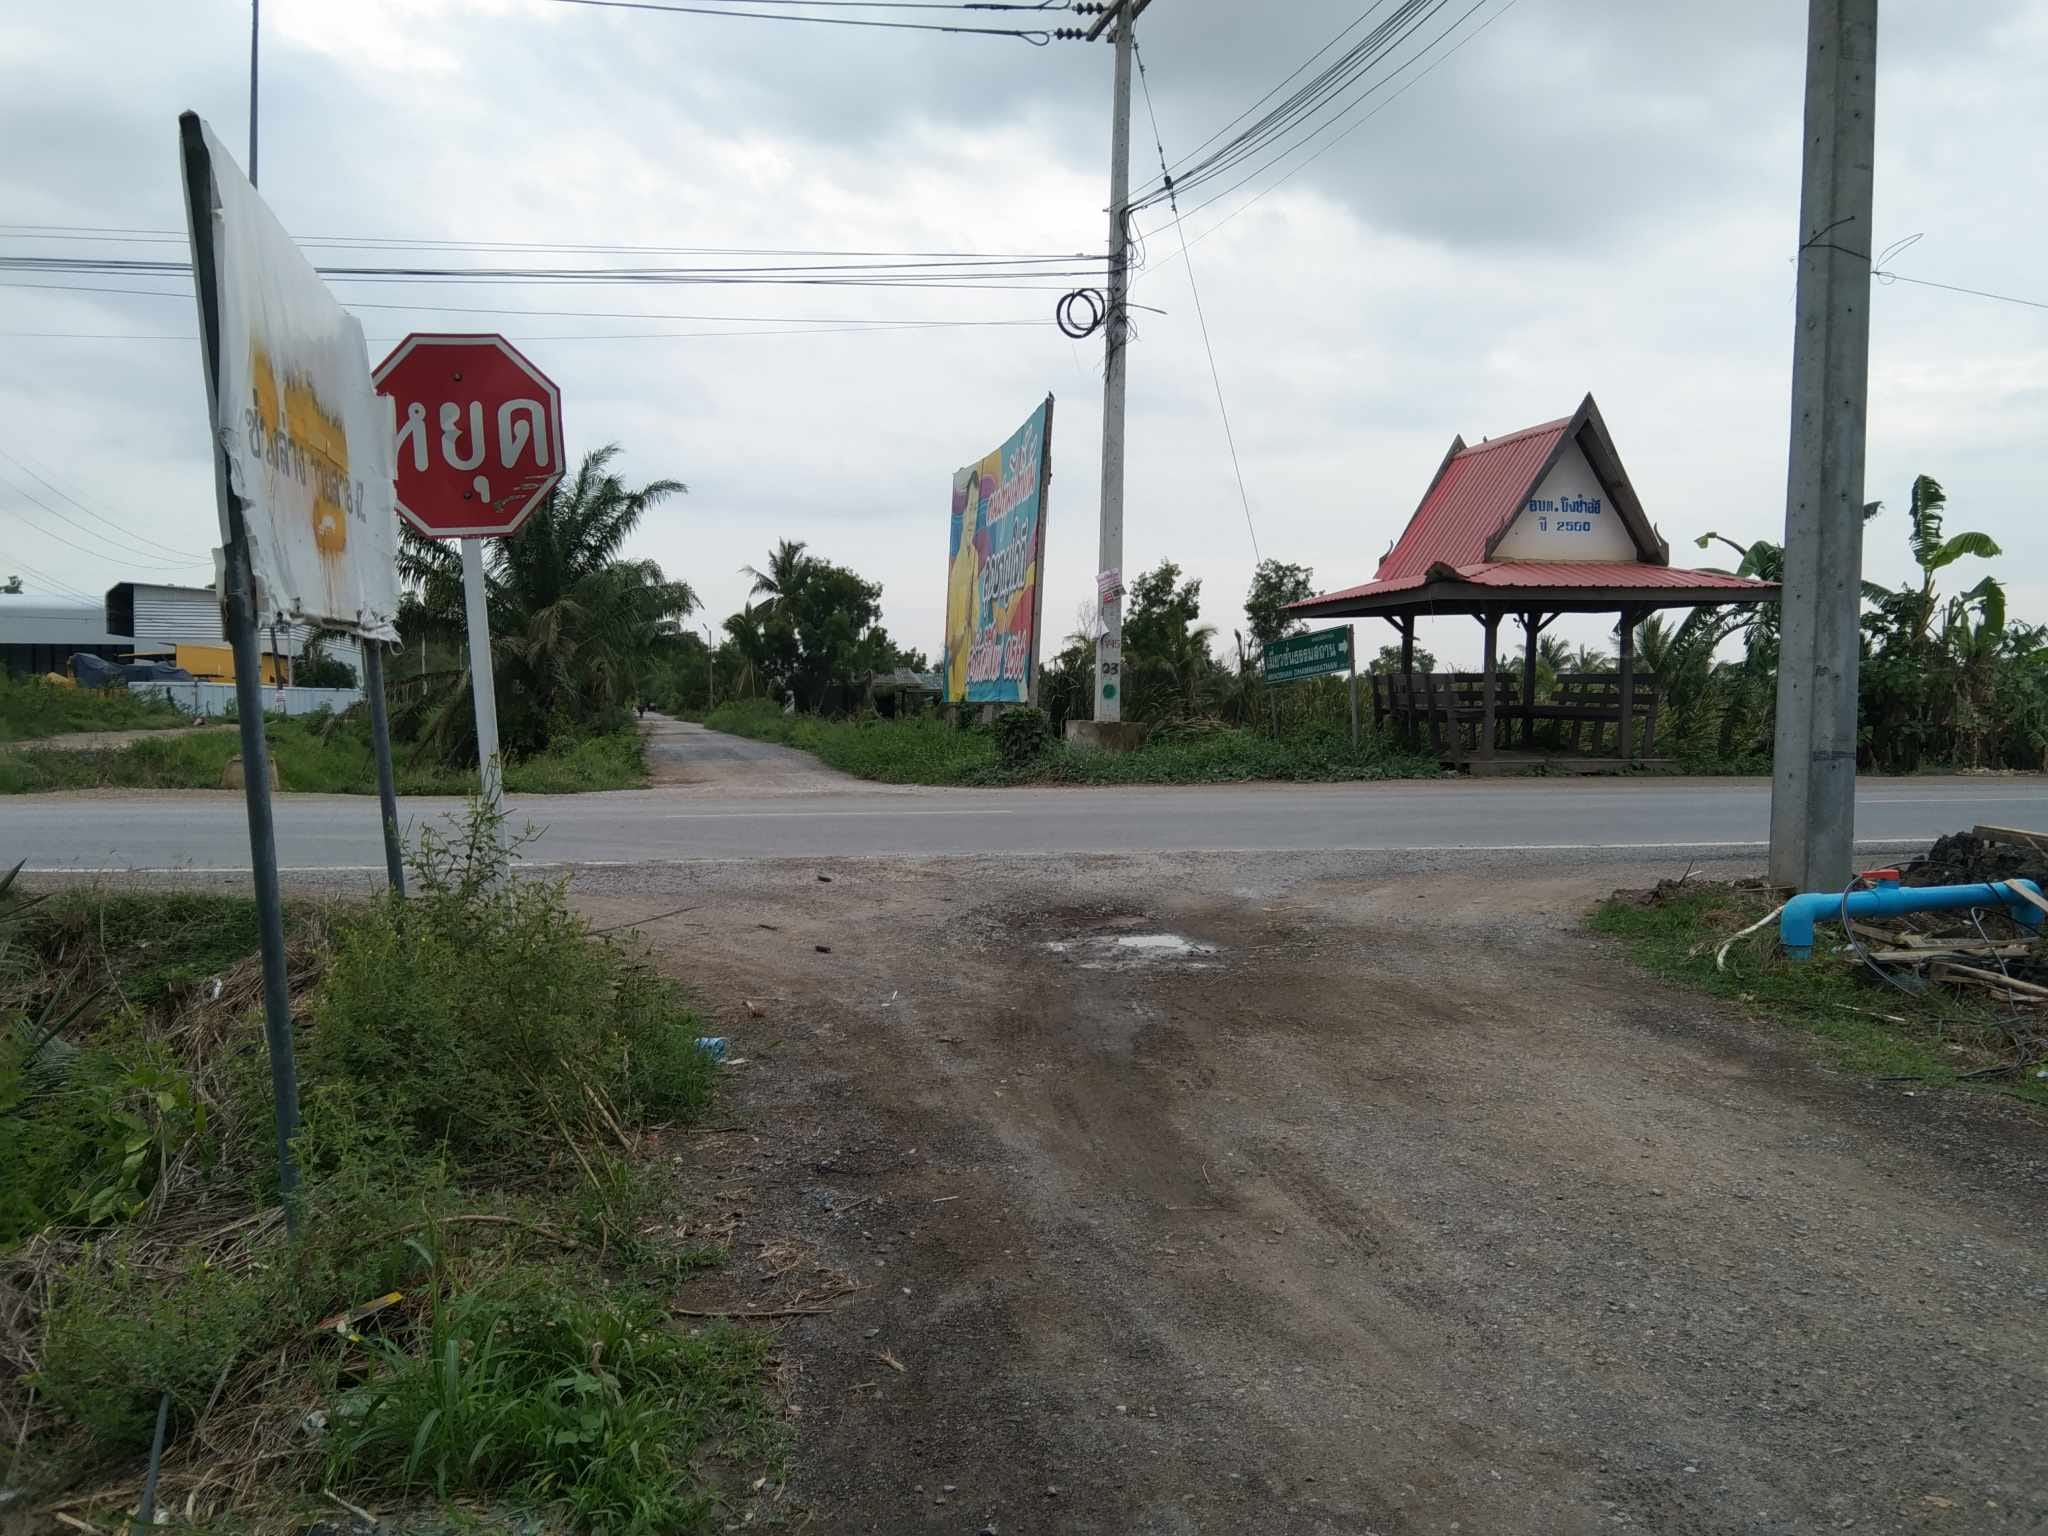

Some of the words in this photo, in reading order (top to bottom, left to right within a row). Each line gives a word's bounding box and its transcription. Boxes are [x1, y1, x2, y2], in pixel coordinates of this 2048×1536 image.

[396, 399, 549, 503] หยุด
[1556, 521, 1591, 532] 2560
[1102, 662, 1119, 675] 23
